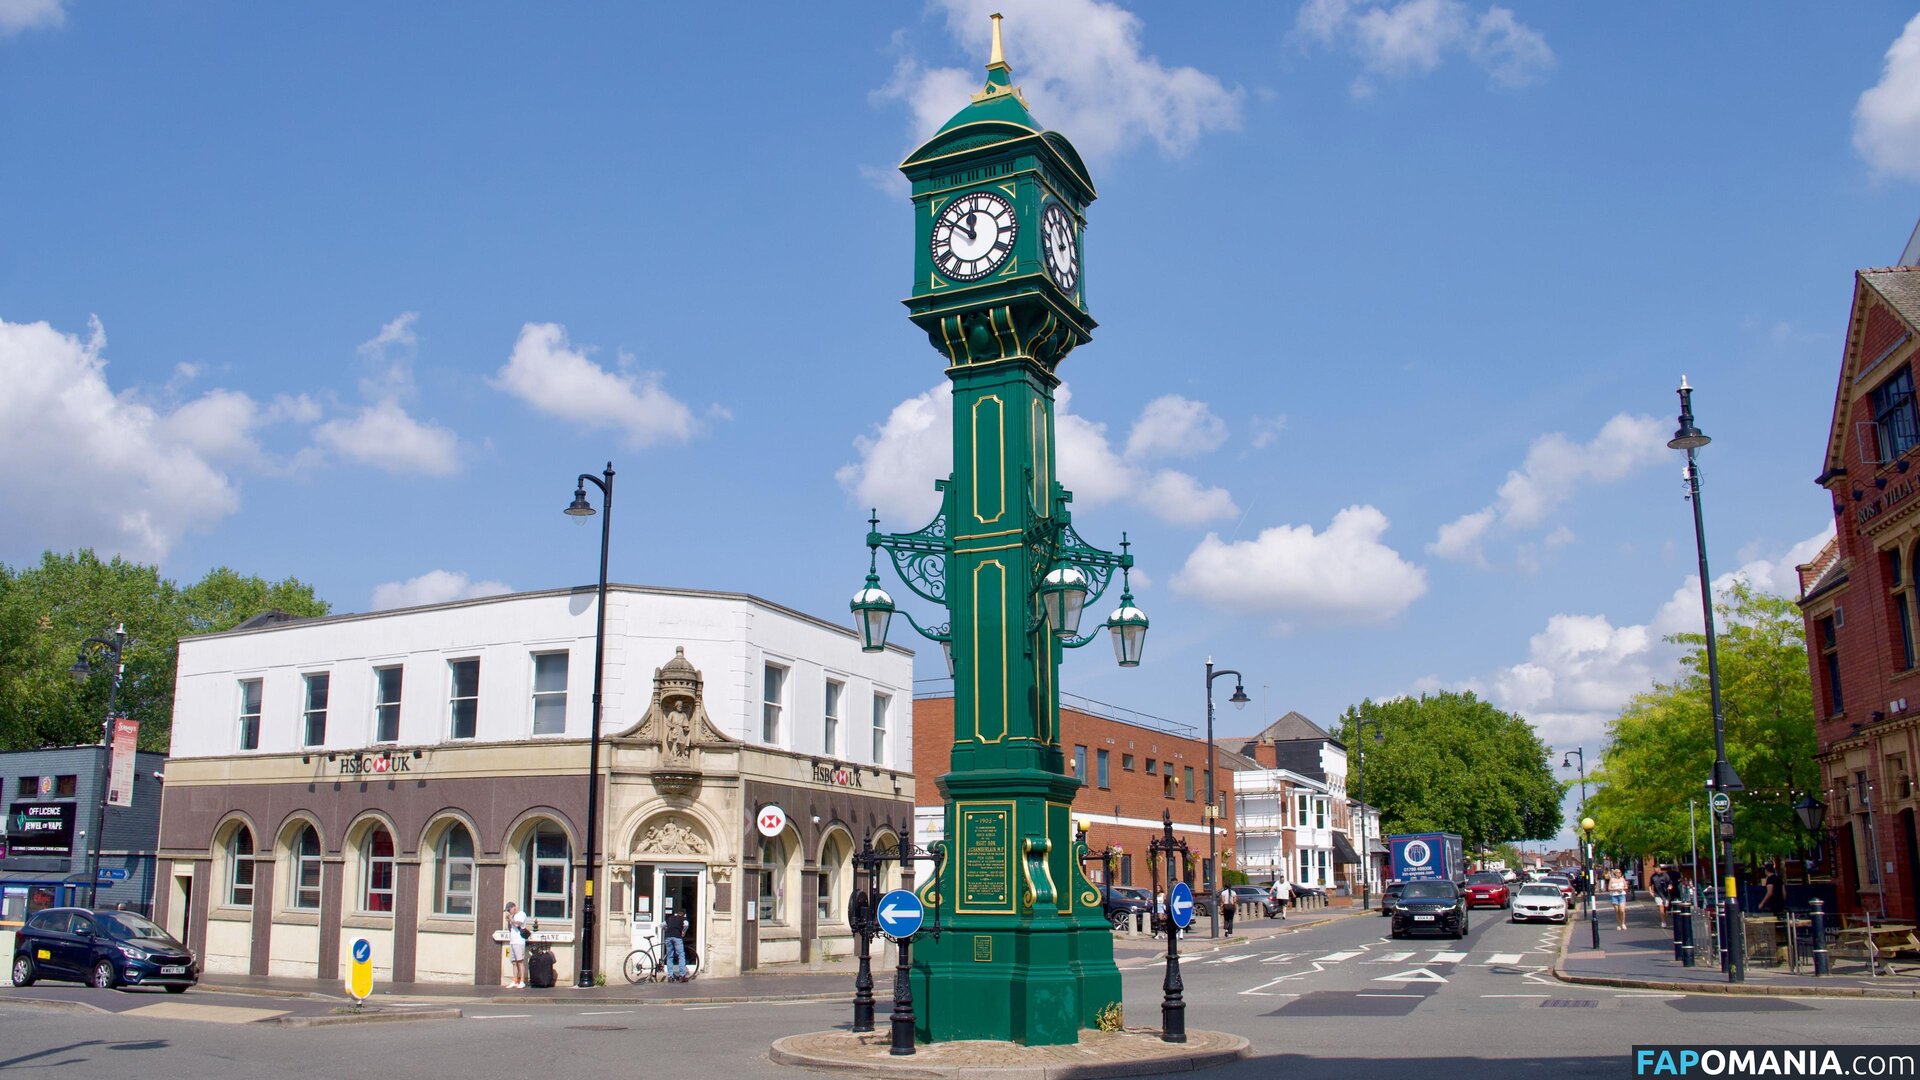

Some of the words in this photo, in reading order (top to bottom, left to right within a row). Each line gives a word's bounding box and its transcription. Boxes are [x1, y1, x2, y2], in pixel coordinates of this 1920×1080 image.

[1882, 480, 1912, 507] VILLA
[340, 757, 372, 774] HSBC
[391, 756, 411, 772] UK
[812, 765, 836, 784] HSBC
[849, 771, 862, 787] UK
[28, 807, 39, 815] OFF
[39, 806, 61, 815] LICENCE
[24, 822, 42, 831] JEWEL
[48, 821, 63, 830] VAPE
